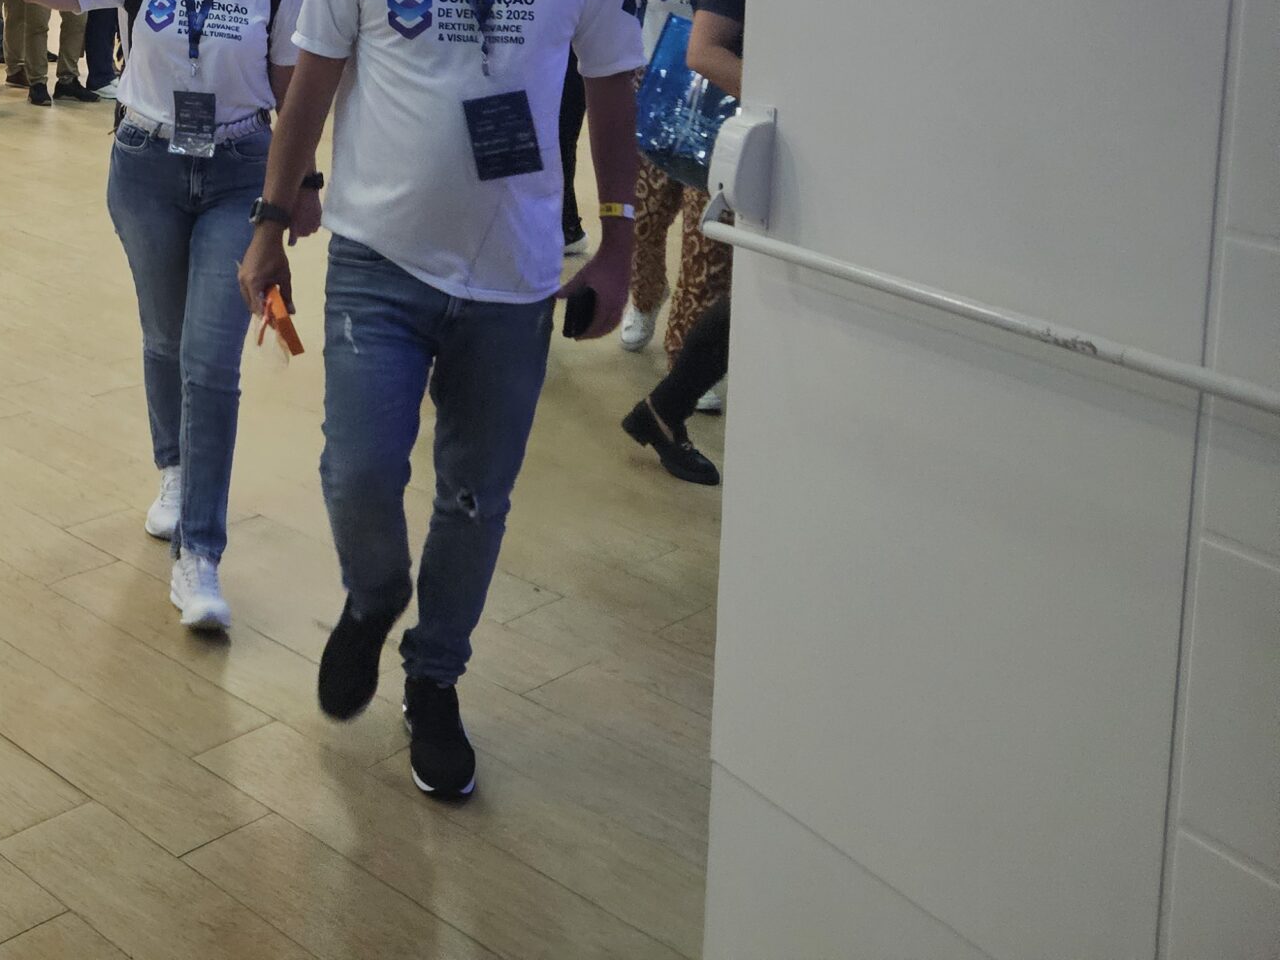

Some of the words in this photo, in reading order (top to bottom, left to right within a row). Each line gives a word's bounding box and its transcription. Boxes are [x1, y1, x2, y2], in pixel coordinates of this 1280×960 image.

[180, 0, 248, 16] CNENÇÃO
[228, 15, 249, 26] 2025
[437, 7, 453, 18] DE
[455, 8, 504, 20] VENAS
[506, 9, 535, 22] 2025
[206, 22, 240, 33] ADVANCE
[438, 21, 475, 32] REXTUR
[478, 23, 522, 33] ADVANCE
[210, 30, 242, 41] TURISMO
[438, 33, 445, 42] &
[447, 33, 480, 44] VISUAL
[484, 35, 525, 46] TURISMO
